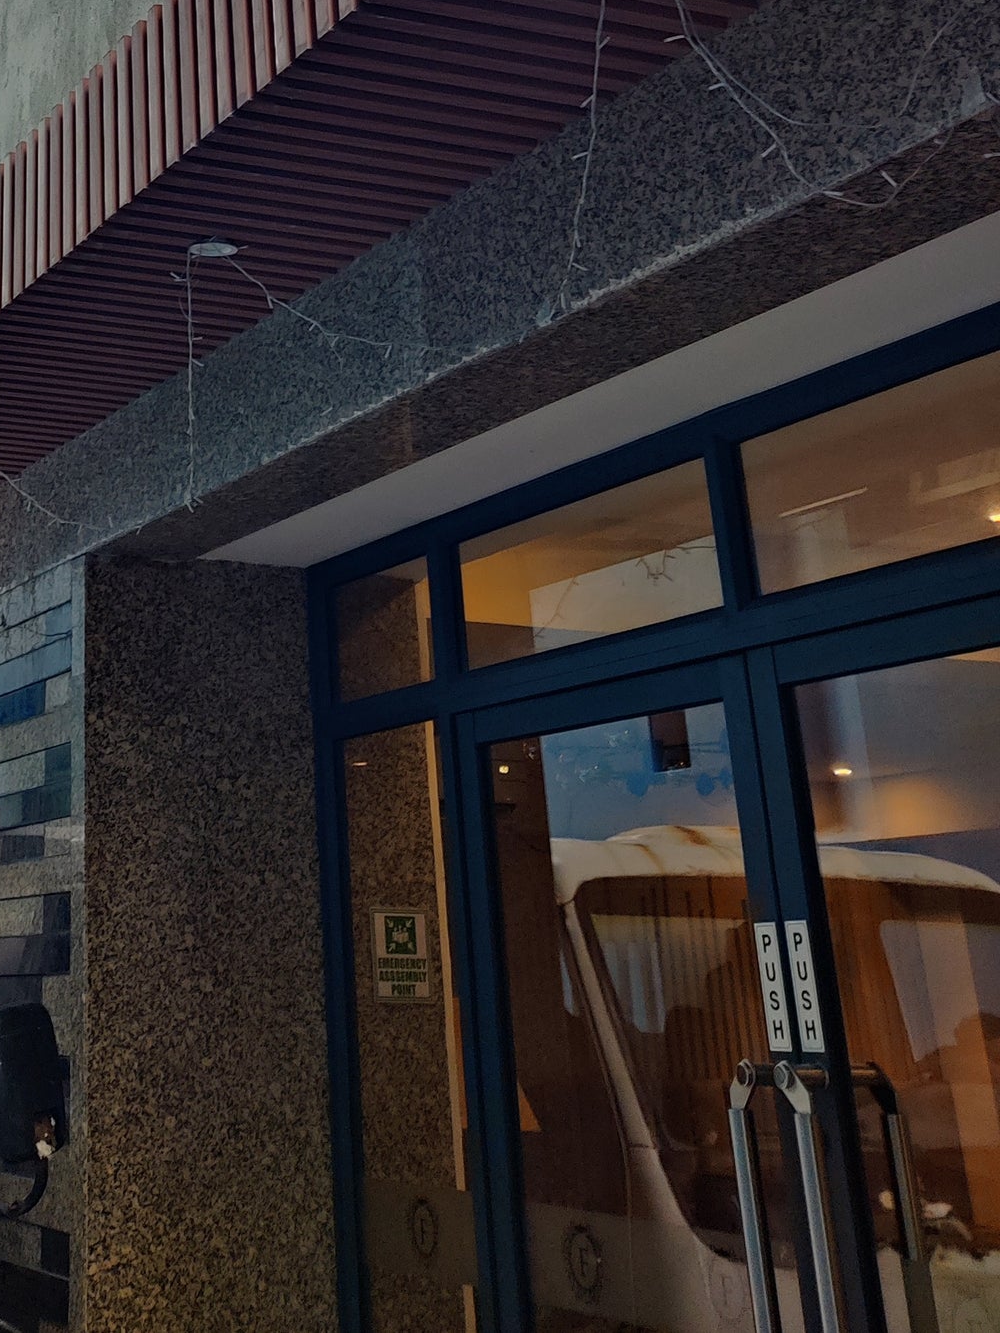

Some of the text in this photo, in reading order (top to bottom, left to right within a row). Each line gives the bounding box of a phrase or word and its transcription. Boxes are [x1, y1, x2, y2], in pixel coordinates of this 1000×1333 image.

[378, 957, 427, 970] EMERGENCY
[391, 984, 417, 996] POINT
[761, 934, 785, 1040] PUSH
[793, 932, 817, 1041] PUSH
